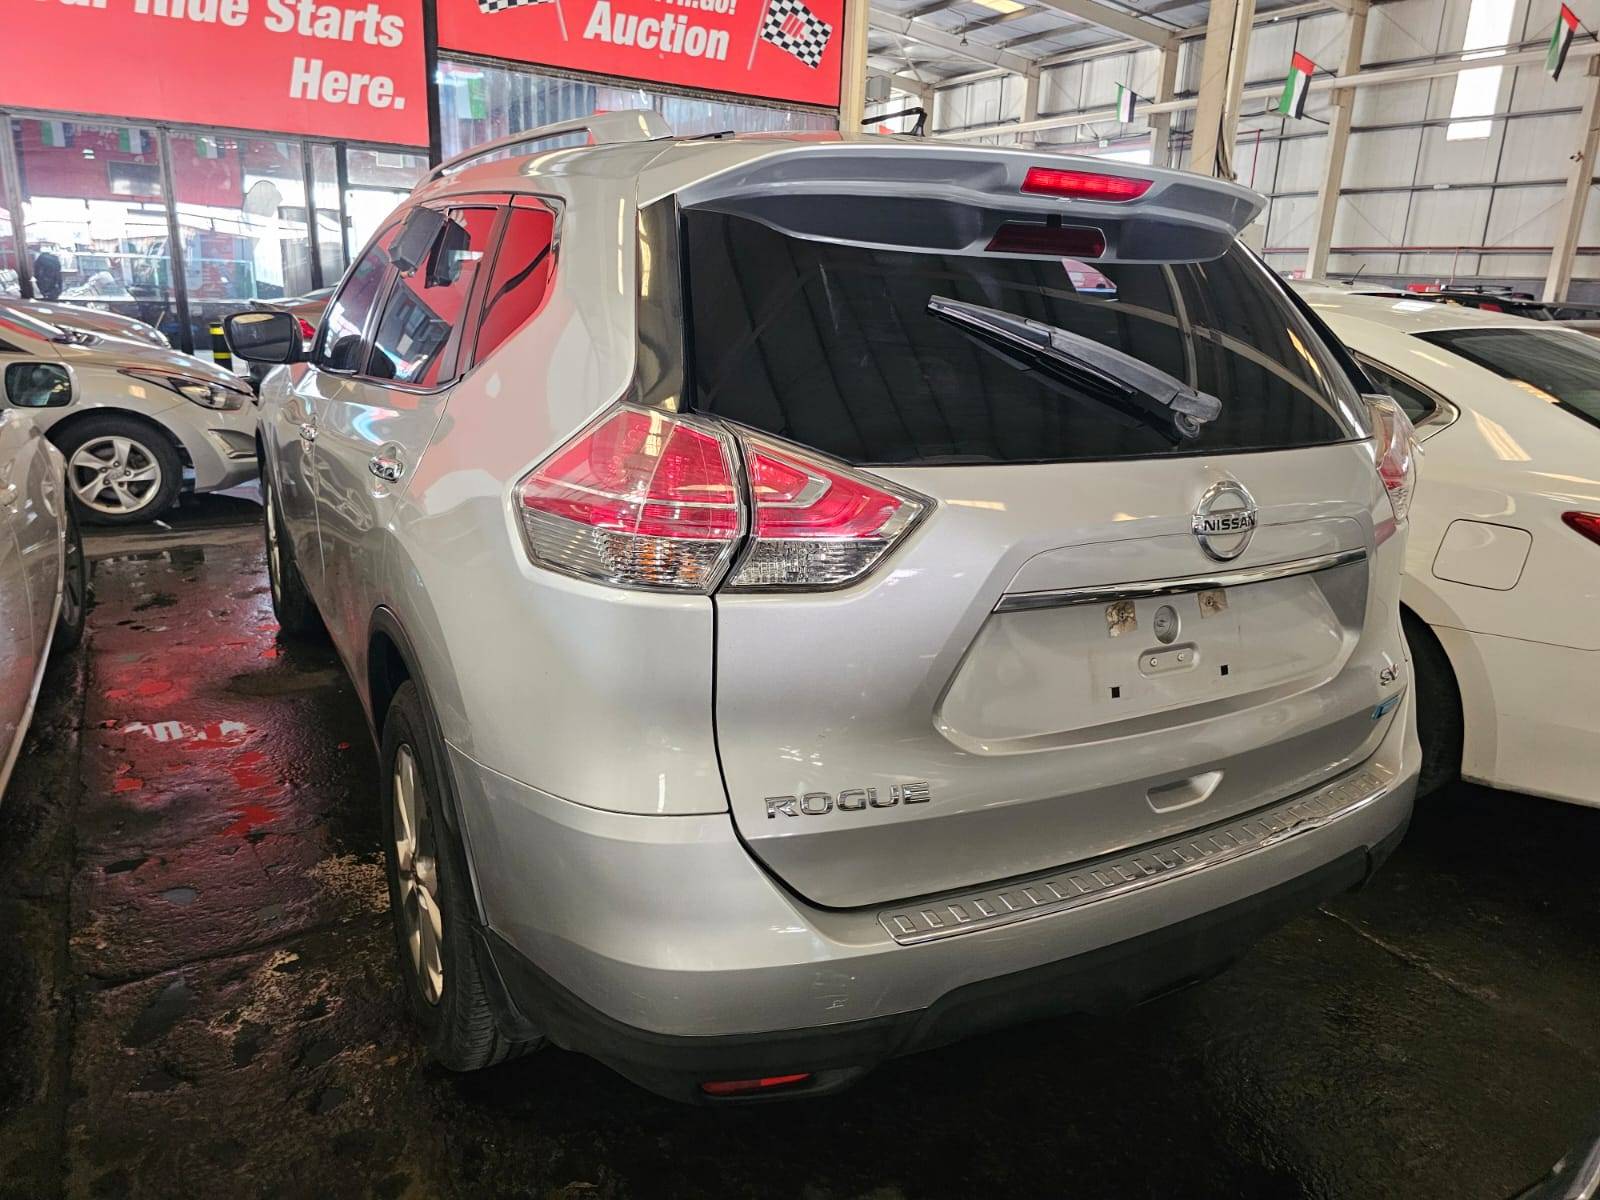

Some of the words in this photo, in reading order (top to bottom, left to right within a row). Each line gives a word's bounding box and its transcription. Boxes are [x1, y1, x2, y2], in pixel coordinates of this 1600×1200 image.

[264, 0, 405, 48] Starts
[583, 1, 730, 61] Auction
[289, 57, 406, 109] Here.
[1203, 511, 1257, 531] NISSAN
[764, 782, 931, 819] ROGUE
